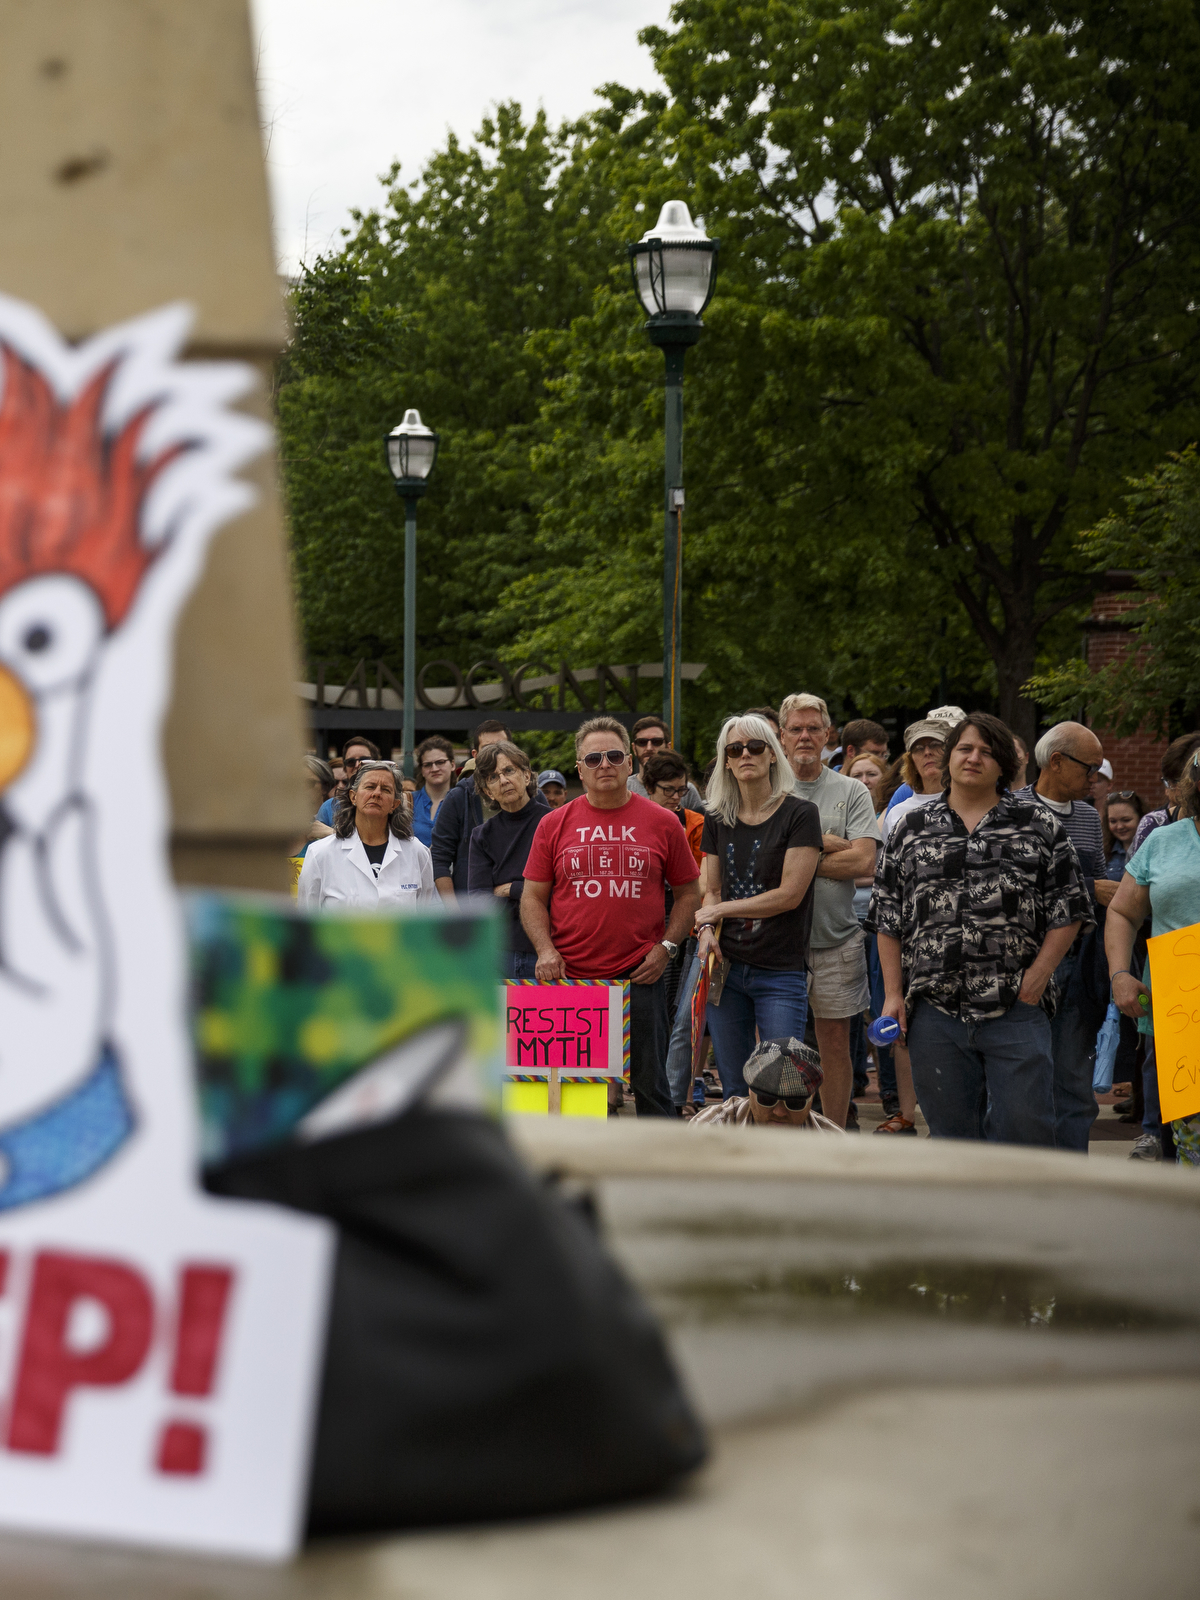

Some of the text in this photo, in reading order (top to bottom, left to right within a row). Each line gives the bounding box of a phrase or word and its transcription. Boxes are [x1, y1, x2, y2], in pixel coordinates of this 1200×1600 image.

[576, 825, 637, 843] TALK
[571, 855, 645, 871] N Er Dy
[572, 879, 642, 899] TO ME
[506, 1006, 609, 1038] RESIST
[517, 1036, 591, 1067] MYTH
